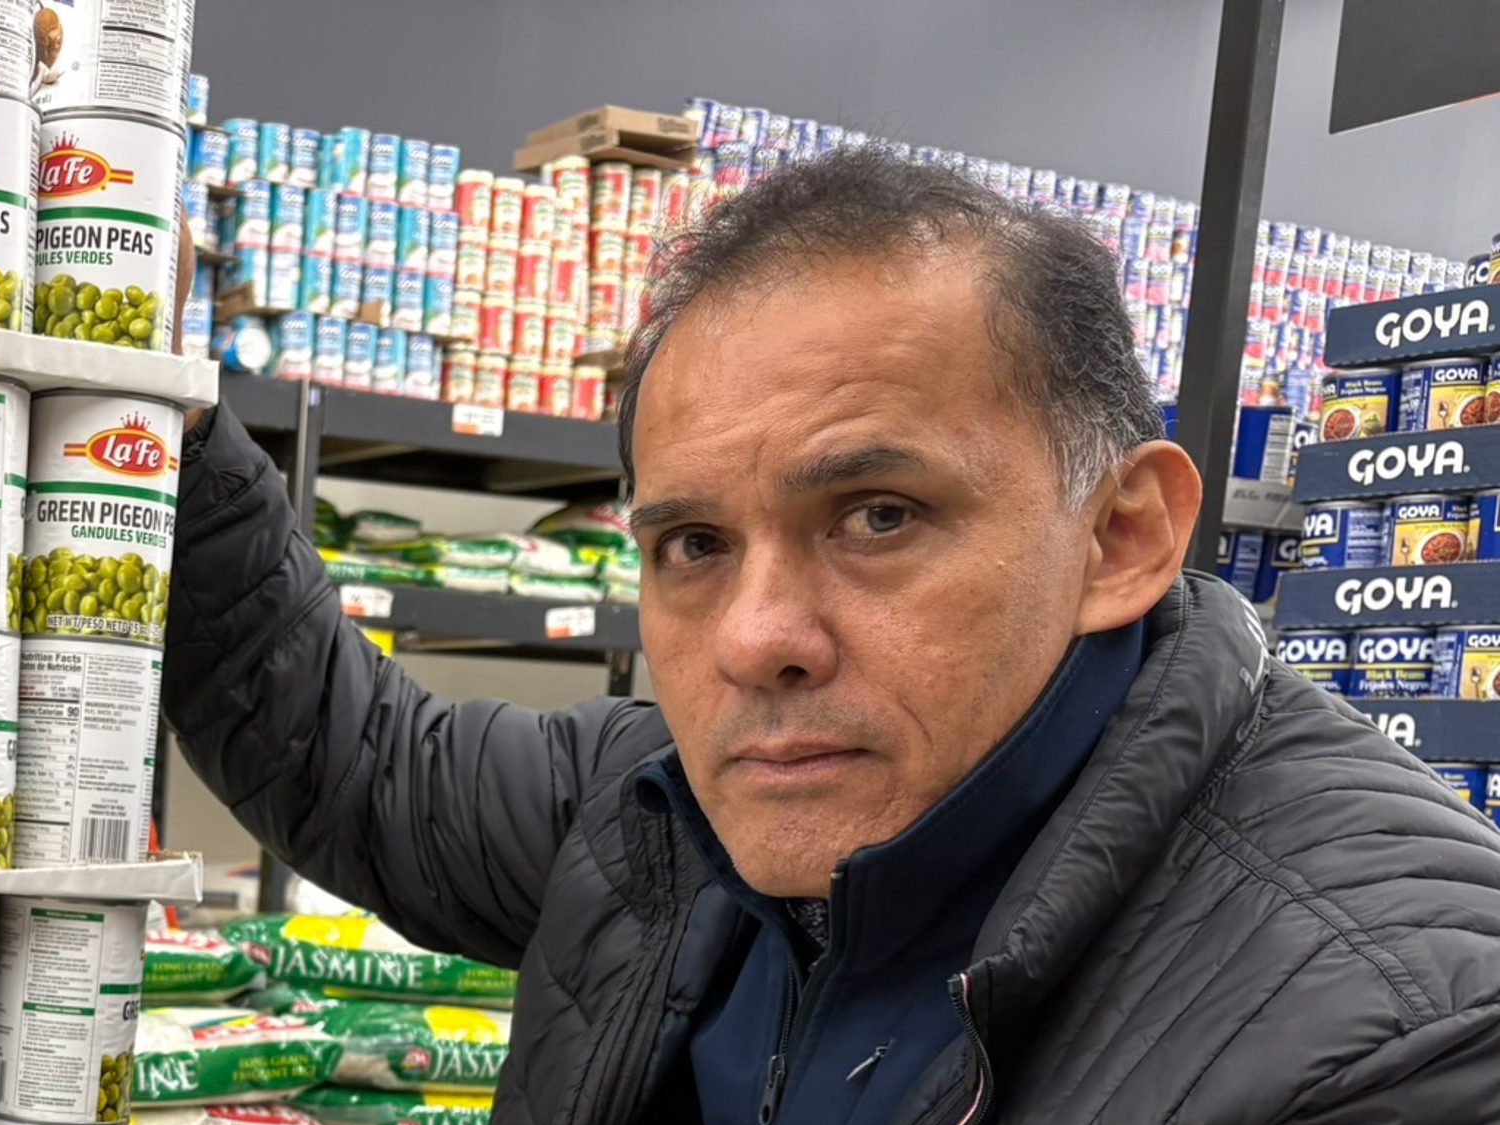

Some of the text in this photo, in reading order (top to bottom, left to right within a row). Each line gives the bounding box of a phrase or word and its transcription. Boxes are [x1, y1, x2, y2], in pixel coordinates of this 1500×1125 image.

[1375, 300, 1489, 348] GOYA
[1435, 366, 1479, 383] GOYA
[1348, 441, 1464, 485] GOYA
[1398, 505, 1443, 521] GOYA
[1335, 575, 1452, 615] GOYA
[273, 946, 424, 989] JASMINE
